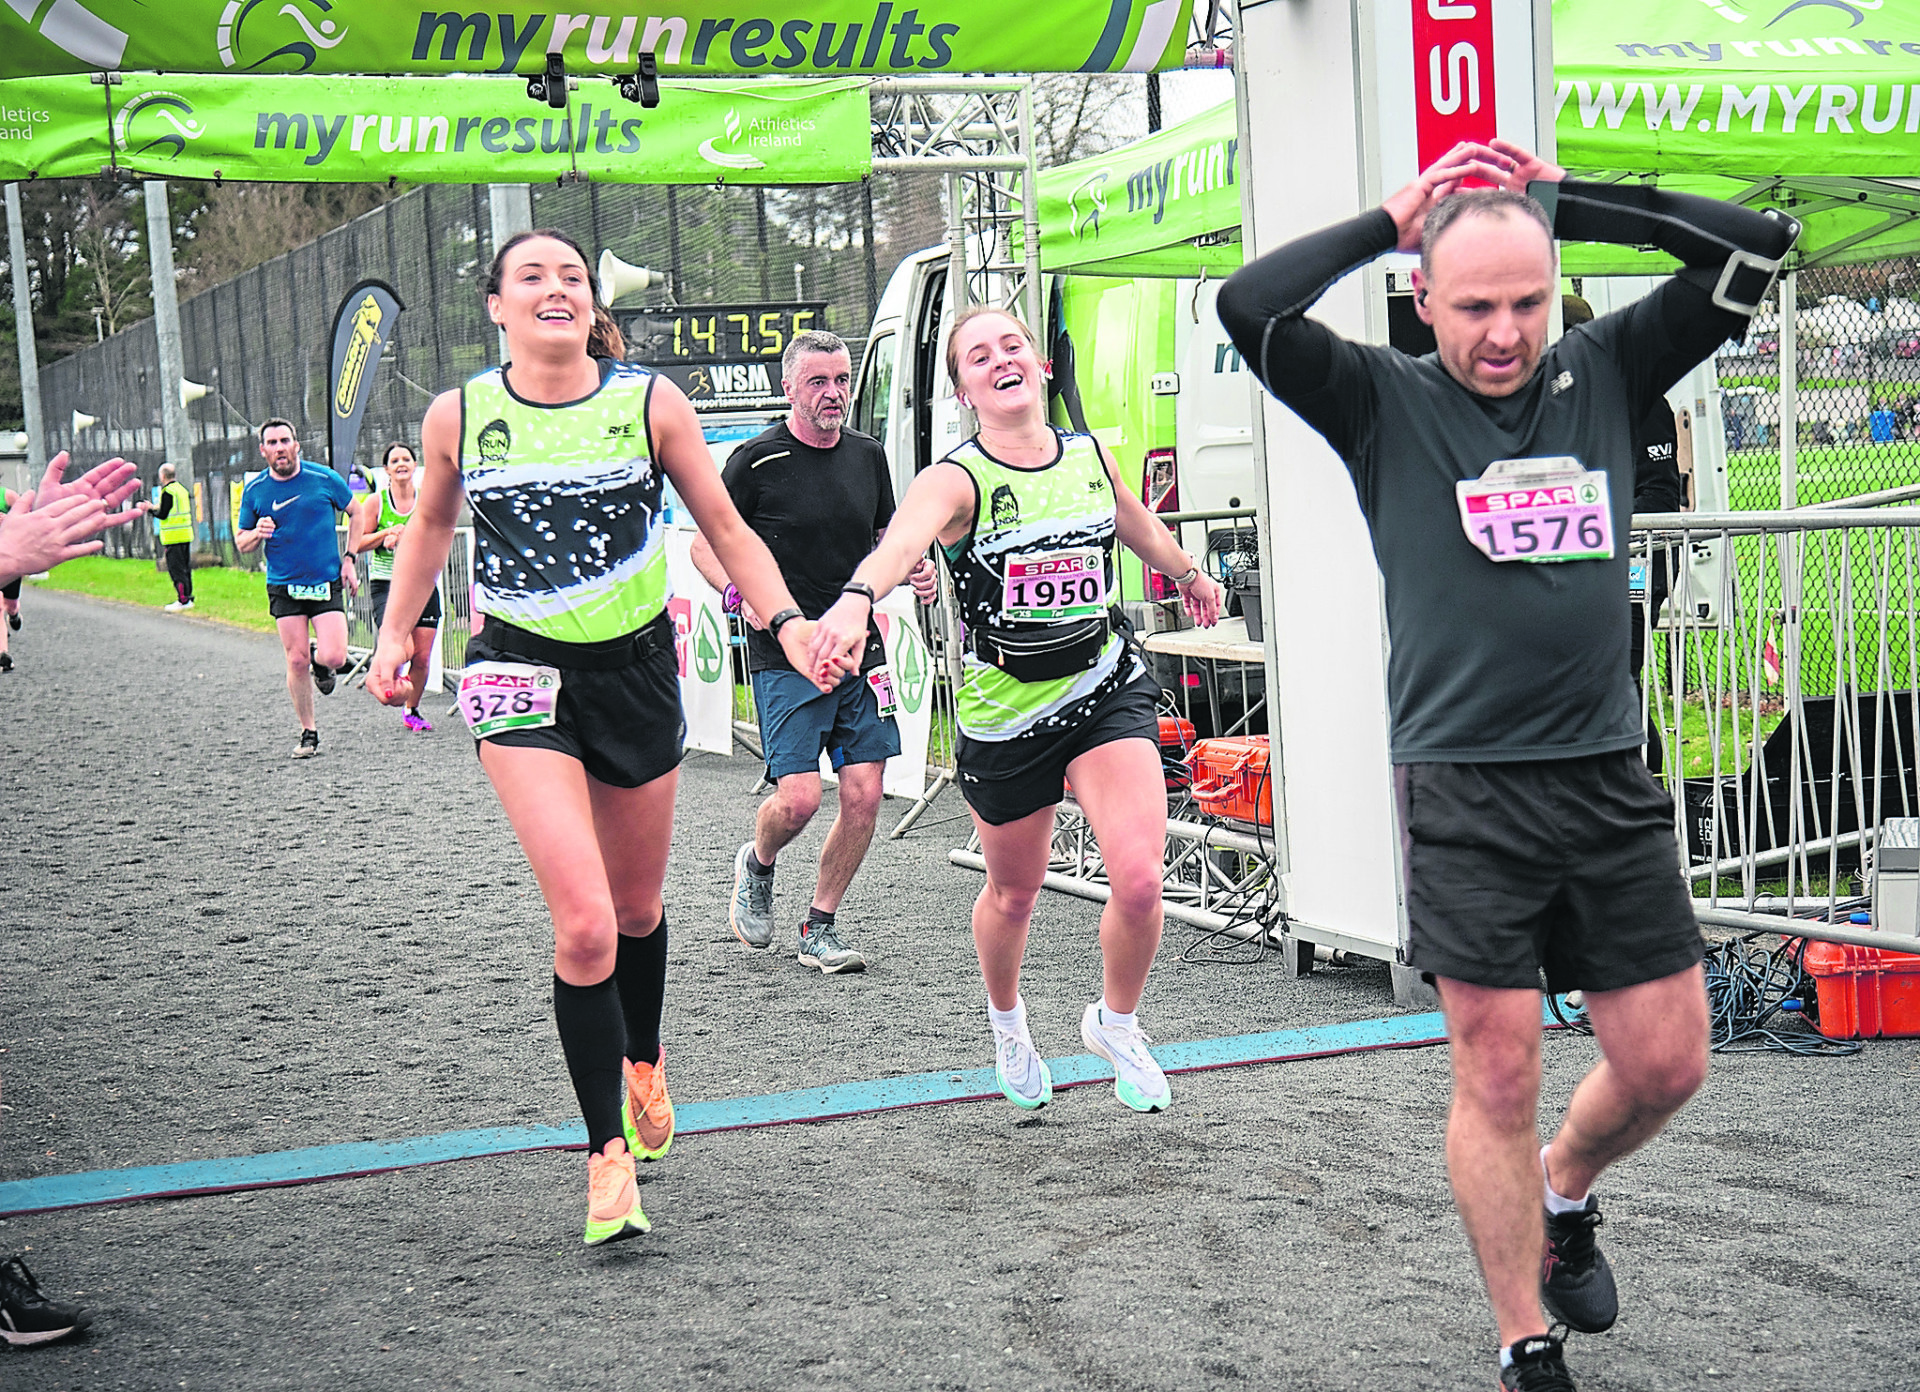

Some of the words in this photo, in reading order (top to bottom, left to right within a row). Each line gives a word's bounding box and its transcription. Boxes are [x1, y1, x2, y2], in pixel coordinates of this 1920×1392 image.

[411, 2, 960, 73] myrunresults
[1555, 80, 1920, 134] WW.MYRU
[254, 103, 643, 166] myrunresults
[748, 116, 816, 131] Athletics
[748, 132, 802, 148] Ireland
[709, 363, 773, 393] WSM
[1486, 488, 1575, 511] SPAR
[1479, 514, 1604, 556] 1576
[1025, 559, 1082, 576] SPAR
[1012, 577, 1099, 607] 1950
[470, 674, 533, 688] SPAR
[469, 691, 534, 723] 328
